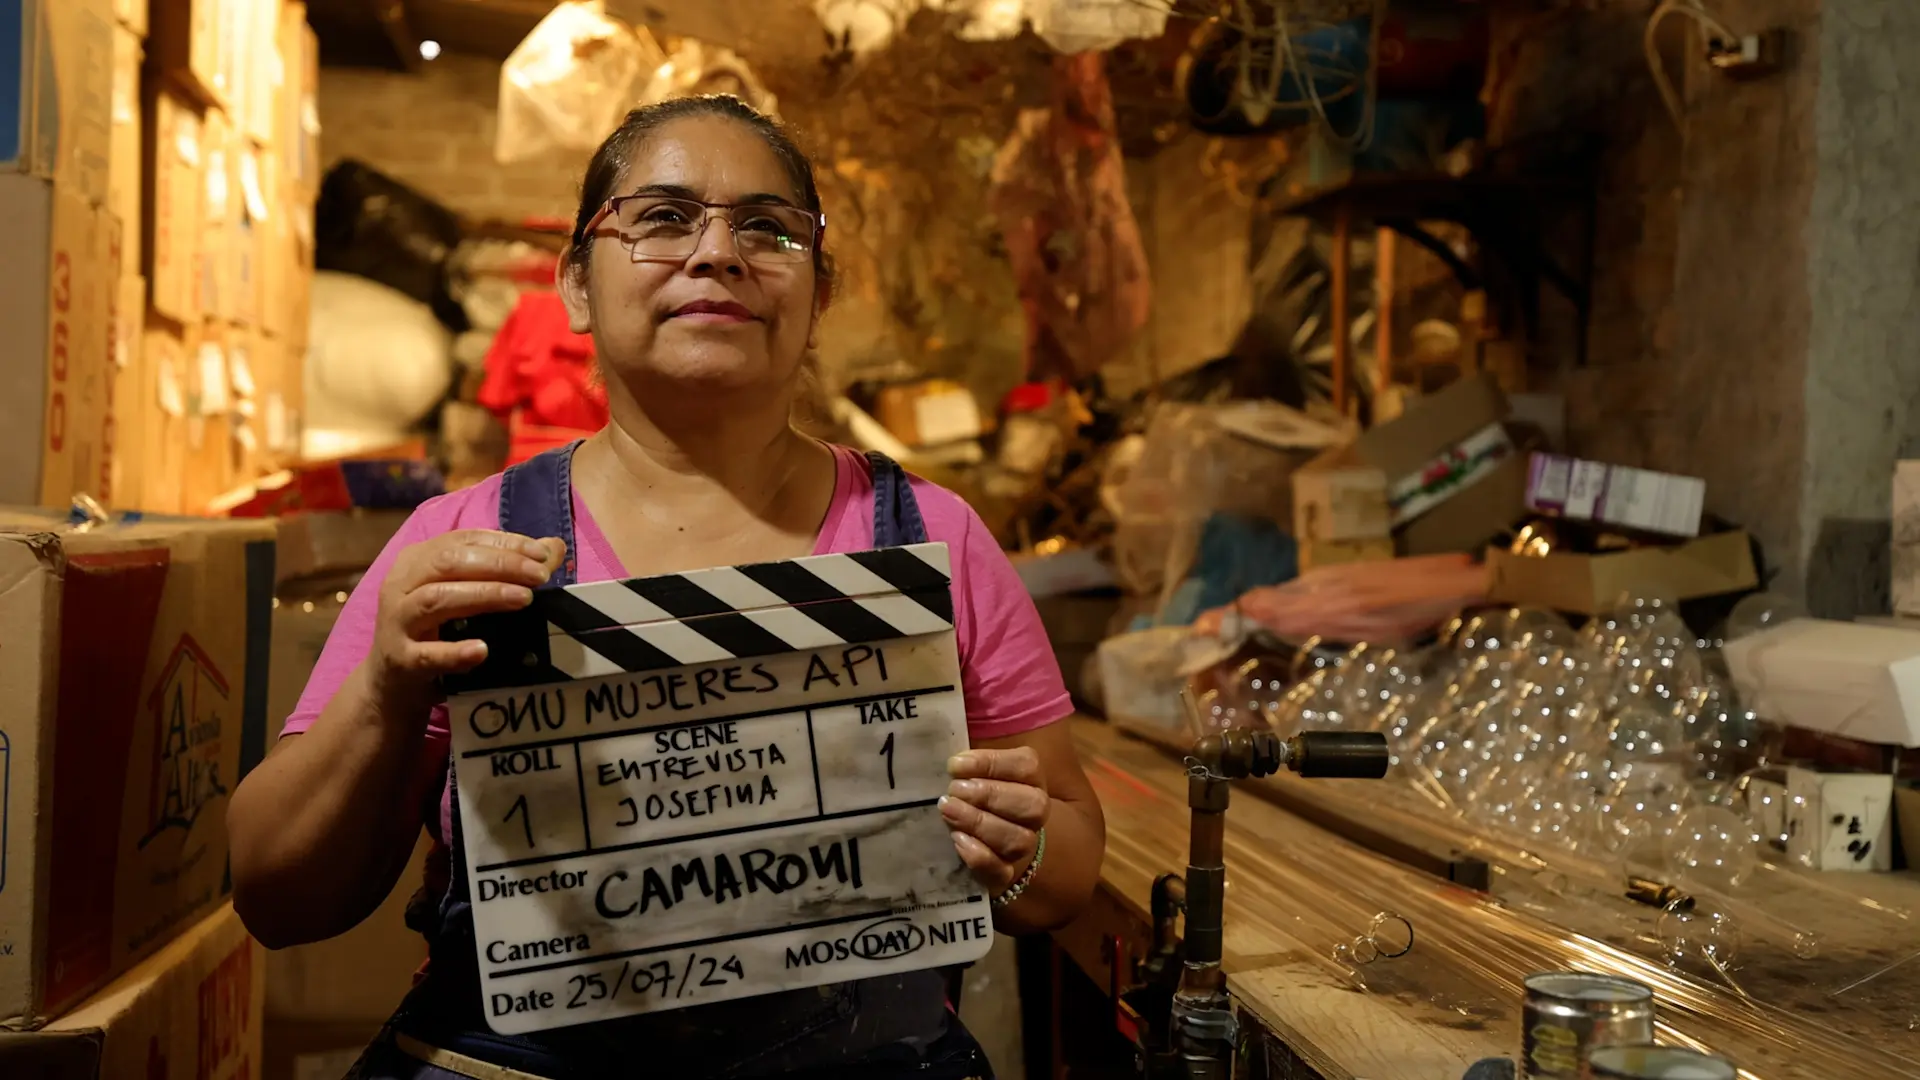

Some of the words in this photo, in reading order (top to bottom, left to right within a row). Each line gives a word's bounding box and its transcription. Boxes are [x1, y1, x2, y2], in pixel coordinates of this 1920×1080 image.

[469, 689, 565, 738] ONU
[585, 663, 779, 724] MUJERES
[803, 645, 888, 691] API
[854, 697, 919, 724] TAKE
[654, 722, 738, 754] SCENE
[490, 748, 562, 777] ROLL
[597, 743, 786, 786] ENTREVISTA
[879, 732, 895, 790] 1
[503, 795, 535, 848] 1
[616, 775, 778, 827] JOSEFINA
[478, 870, 588, 902] Director
[595, 837, 863, 919] CAMARONI
[486, 933, 590, 964] Camera
[786, 938, 849, 969] MOS
[862, 923, 914, 958] DAY
[929, 917, 988, 946] NITE
[491, 989, 554, 1016] Date
